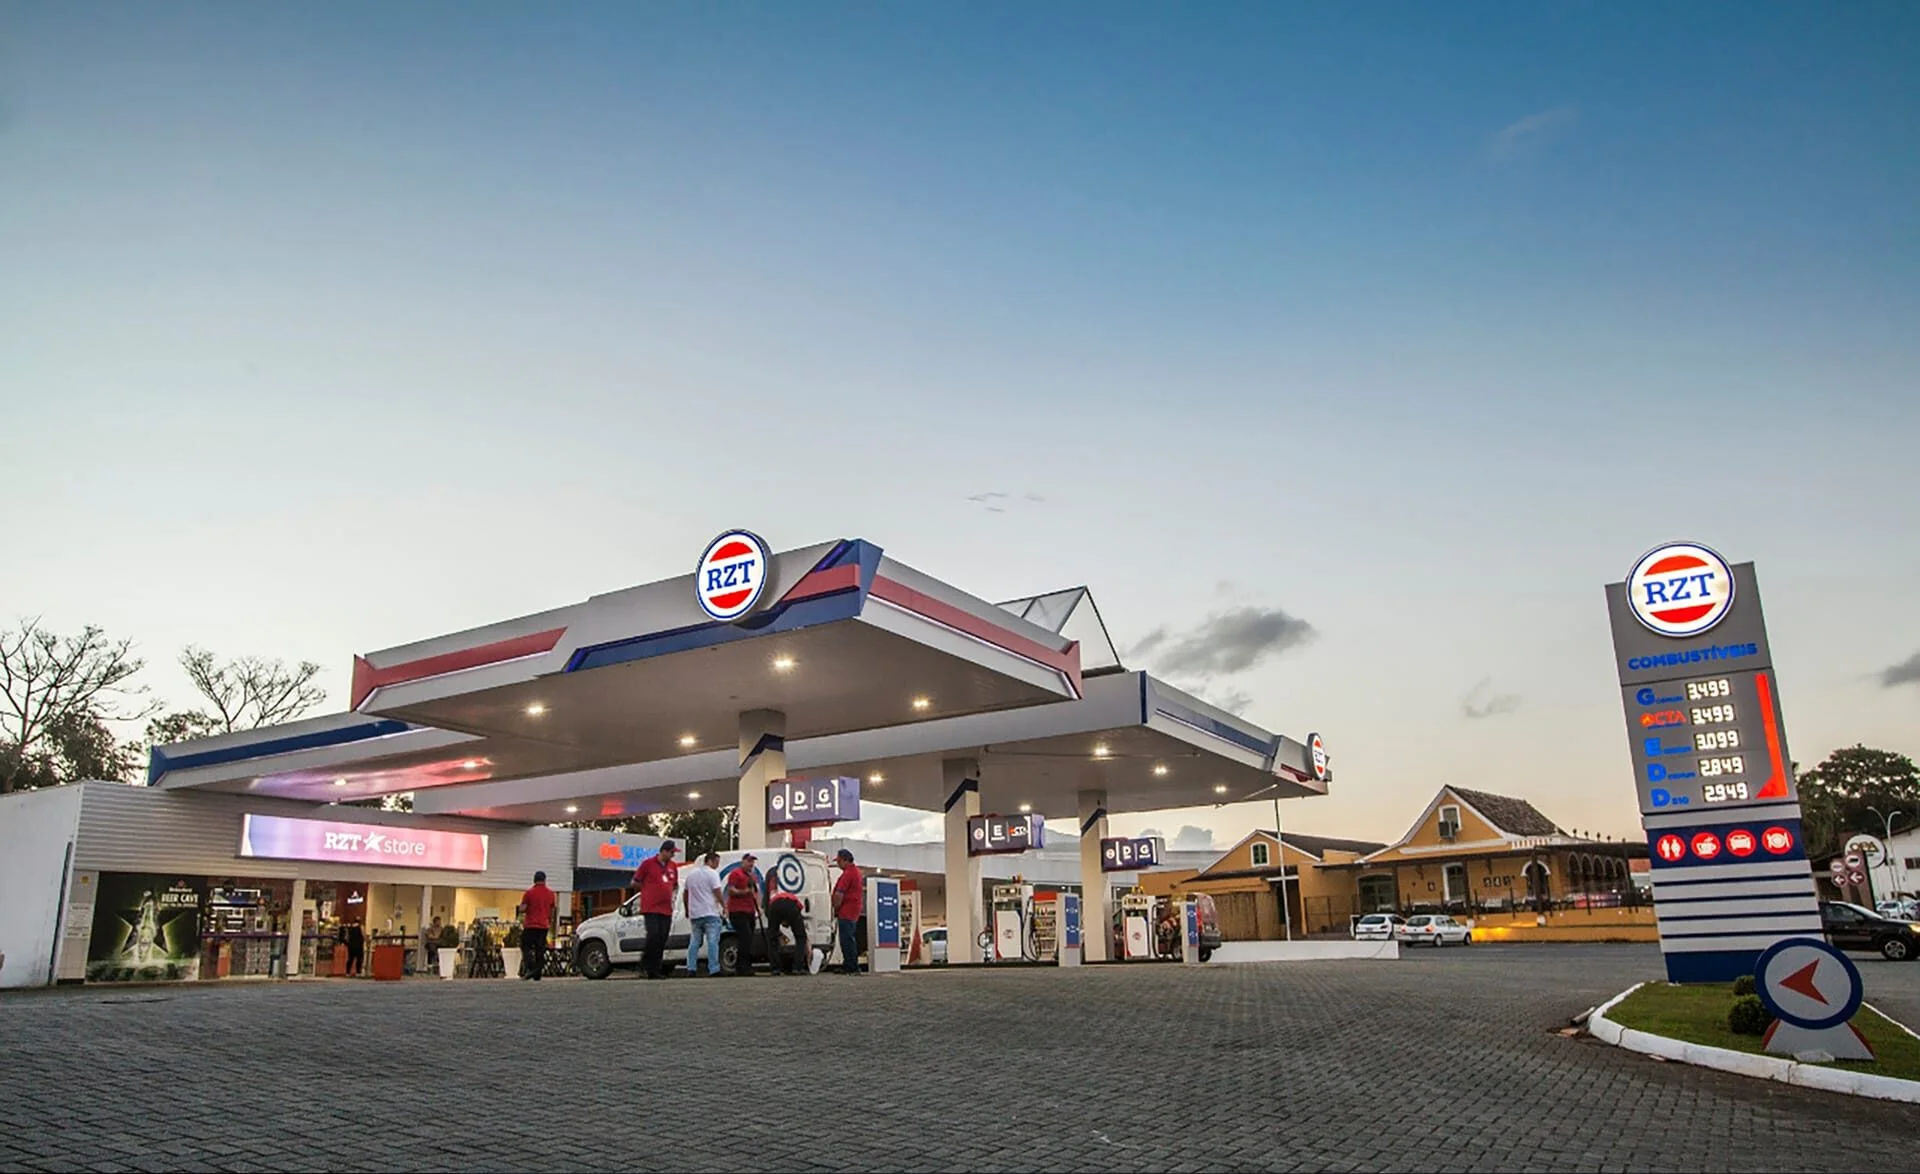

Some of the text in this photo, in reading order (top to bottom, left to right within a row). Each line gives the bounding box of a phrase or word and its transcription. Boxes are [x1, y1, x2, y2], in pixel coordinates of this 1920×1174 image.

[706, 559, 755, 591] RZT
[1643, 572, 1715, 605] RZT
[1628, 642, 1758, 670] COMBUSTÍVEIS
[1636, 687, 1656, 706] G
[1645, 737, 1661, 756] E
[1647, 763, 1667, 782] D
[794, 791, 805, 804] D
[818, 789, 830, 803] G
[1651, 788, 1671, 807] D
[993, 825, 1003, 836] E
[324, 832, 425, 856] RZT store
[1140, 845, 1150, 854] G
